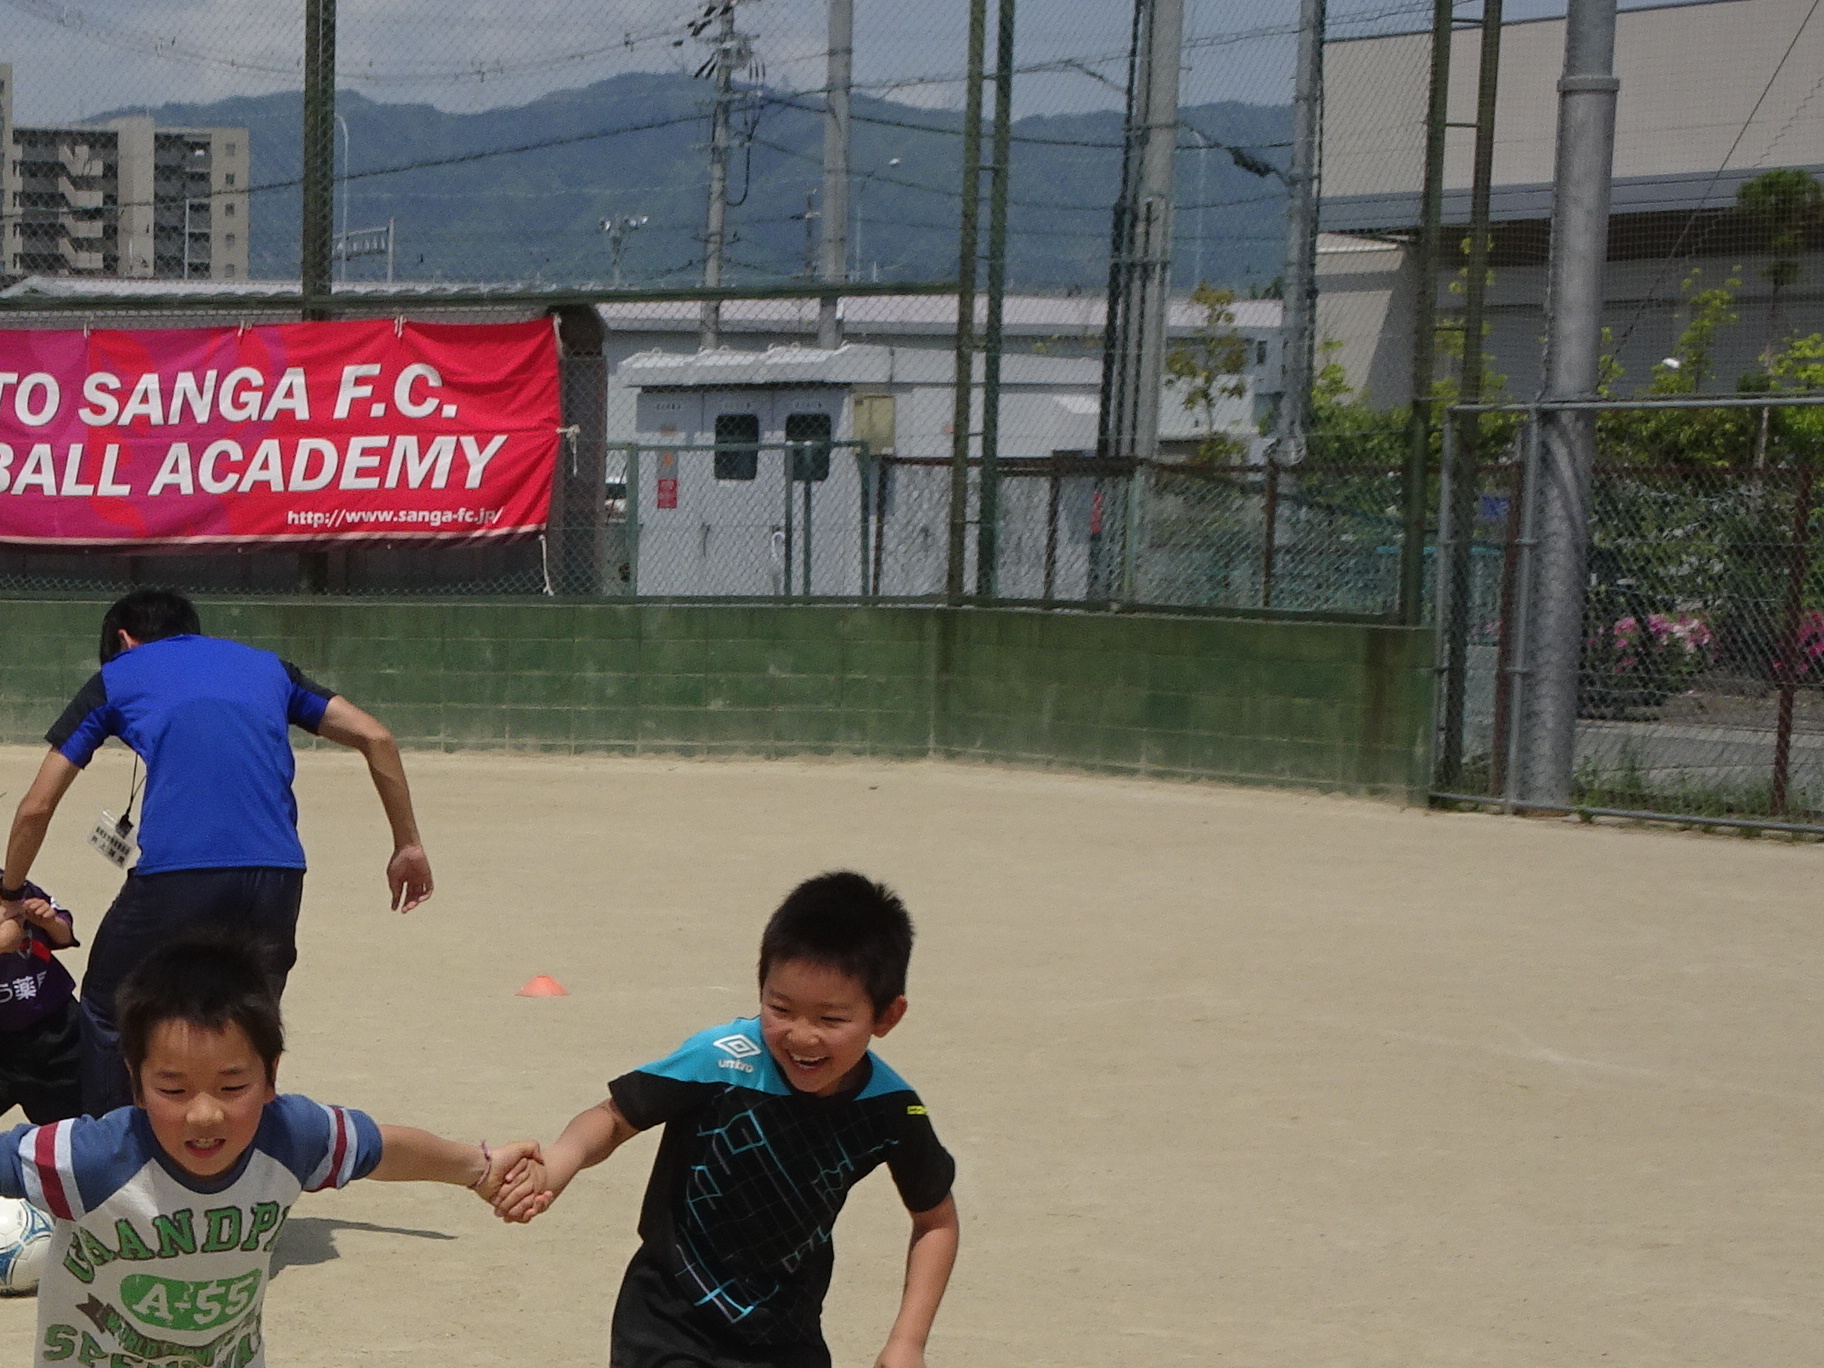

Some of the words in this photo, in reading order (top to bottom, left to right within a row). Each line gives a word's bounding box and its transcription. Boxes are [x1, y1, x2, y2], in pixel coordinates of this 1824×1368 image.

[78, 366, 312, 426] SANGA
[332, 363, 458, 419] F.C.
[148, 434, 508, 496] ACADEMY
[286, 506, 505, 528] http://www.sanga-fc.jp/
[717, 1058, 754, 1074] umbro
